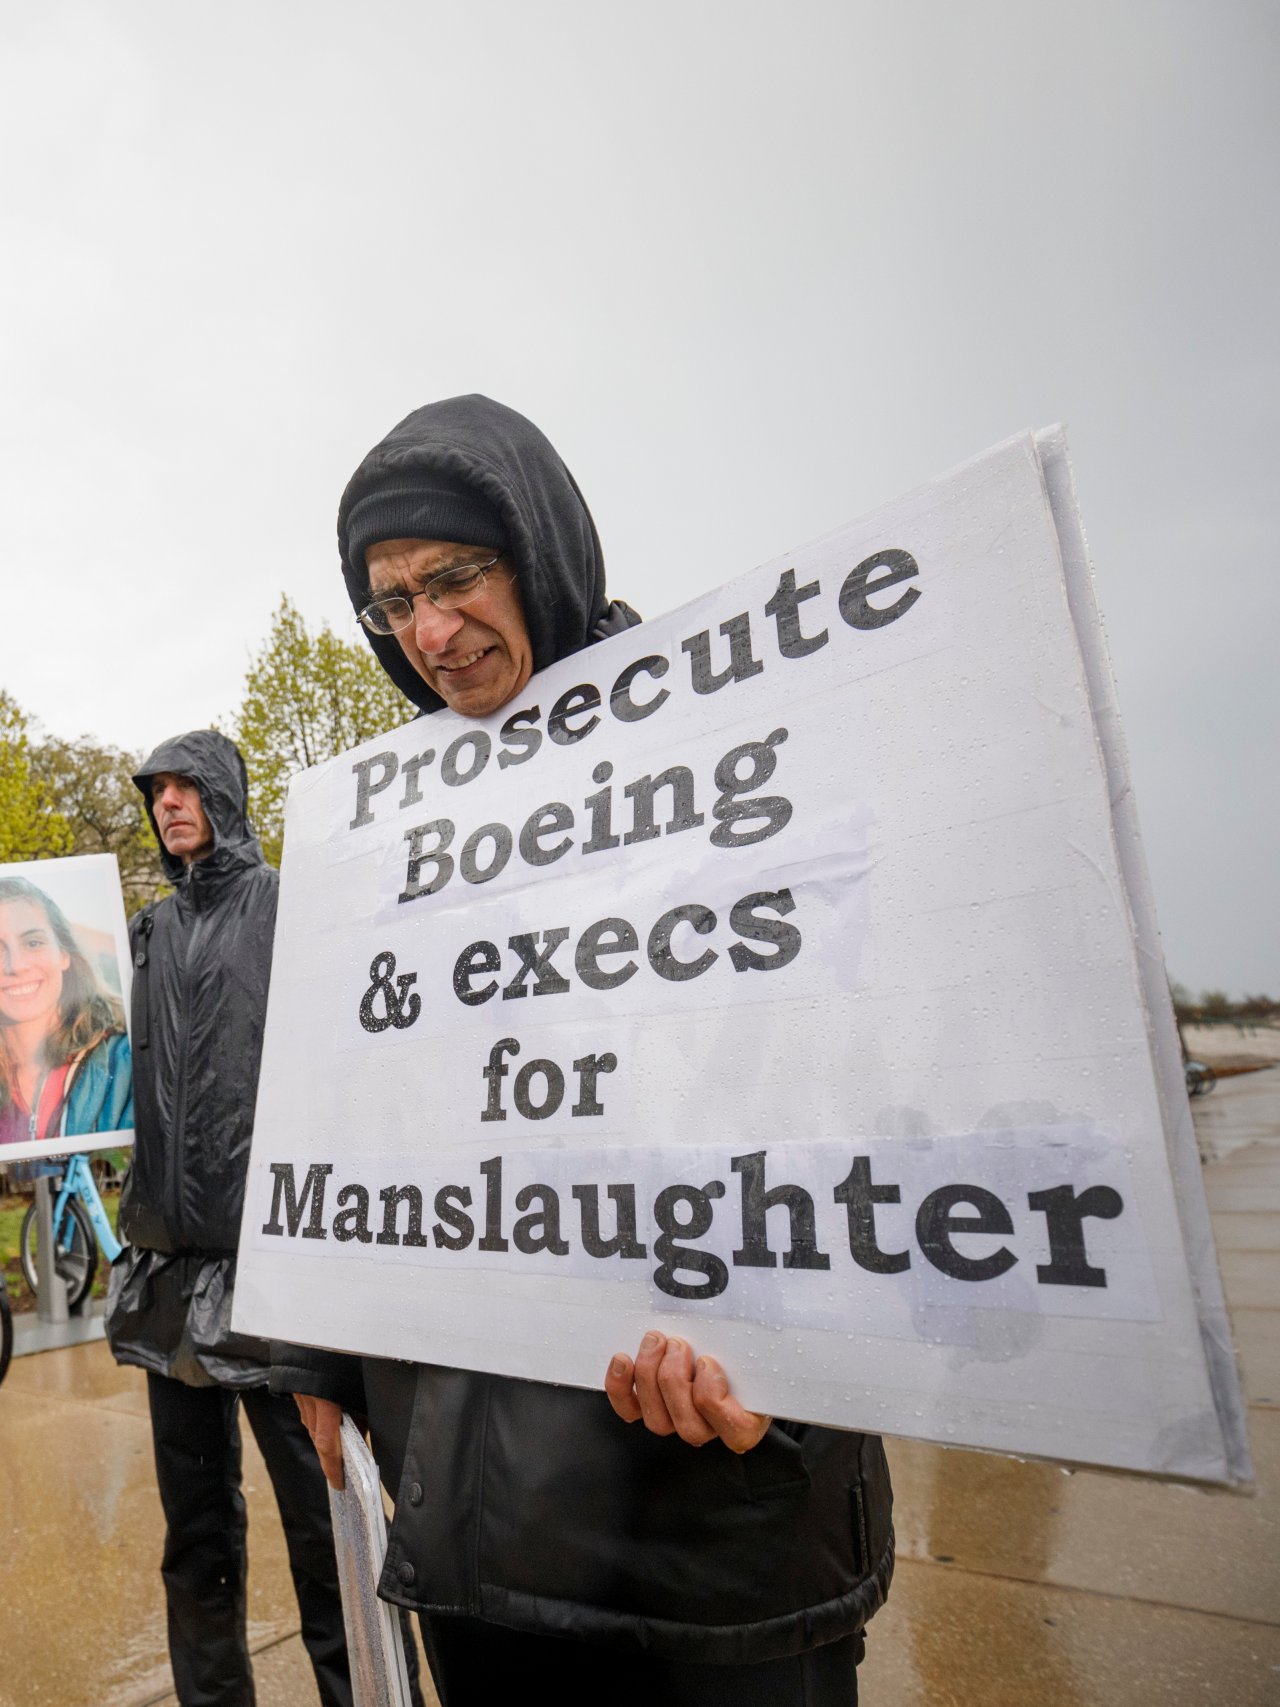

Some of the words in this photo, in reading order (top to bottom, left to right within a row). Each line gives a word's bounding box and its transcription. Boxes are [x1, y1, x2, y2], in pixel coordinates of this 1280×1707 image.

[349, 548, 922, 829] Prosecute
[398, 727, 792, 904] Boeing
[360, 952, 421, 1033] &
[453, 888, 801, 1006] execs
[481, 1038, 617, 1121] for
[262, 1151, 1124, 1299] Manslaughter
